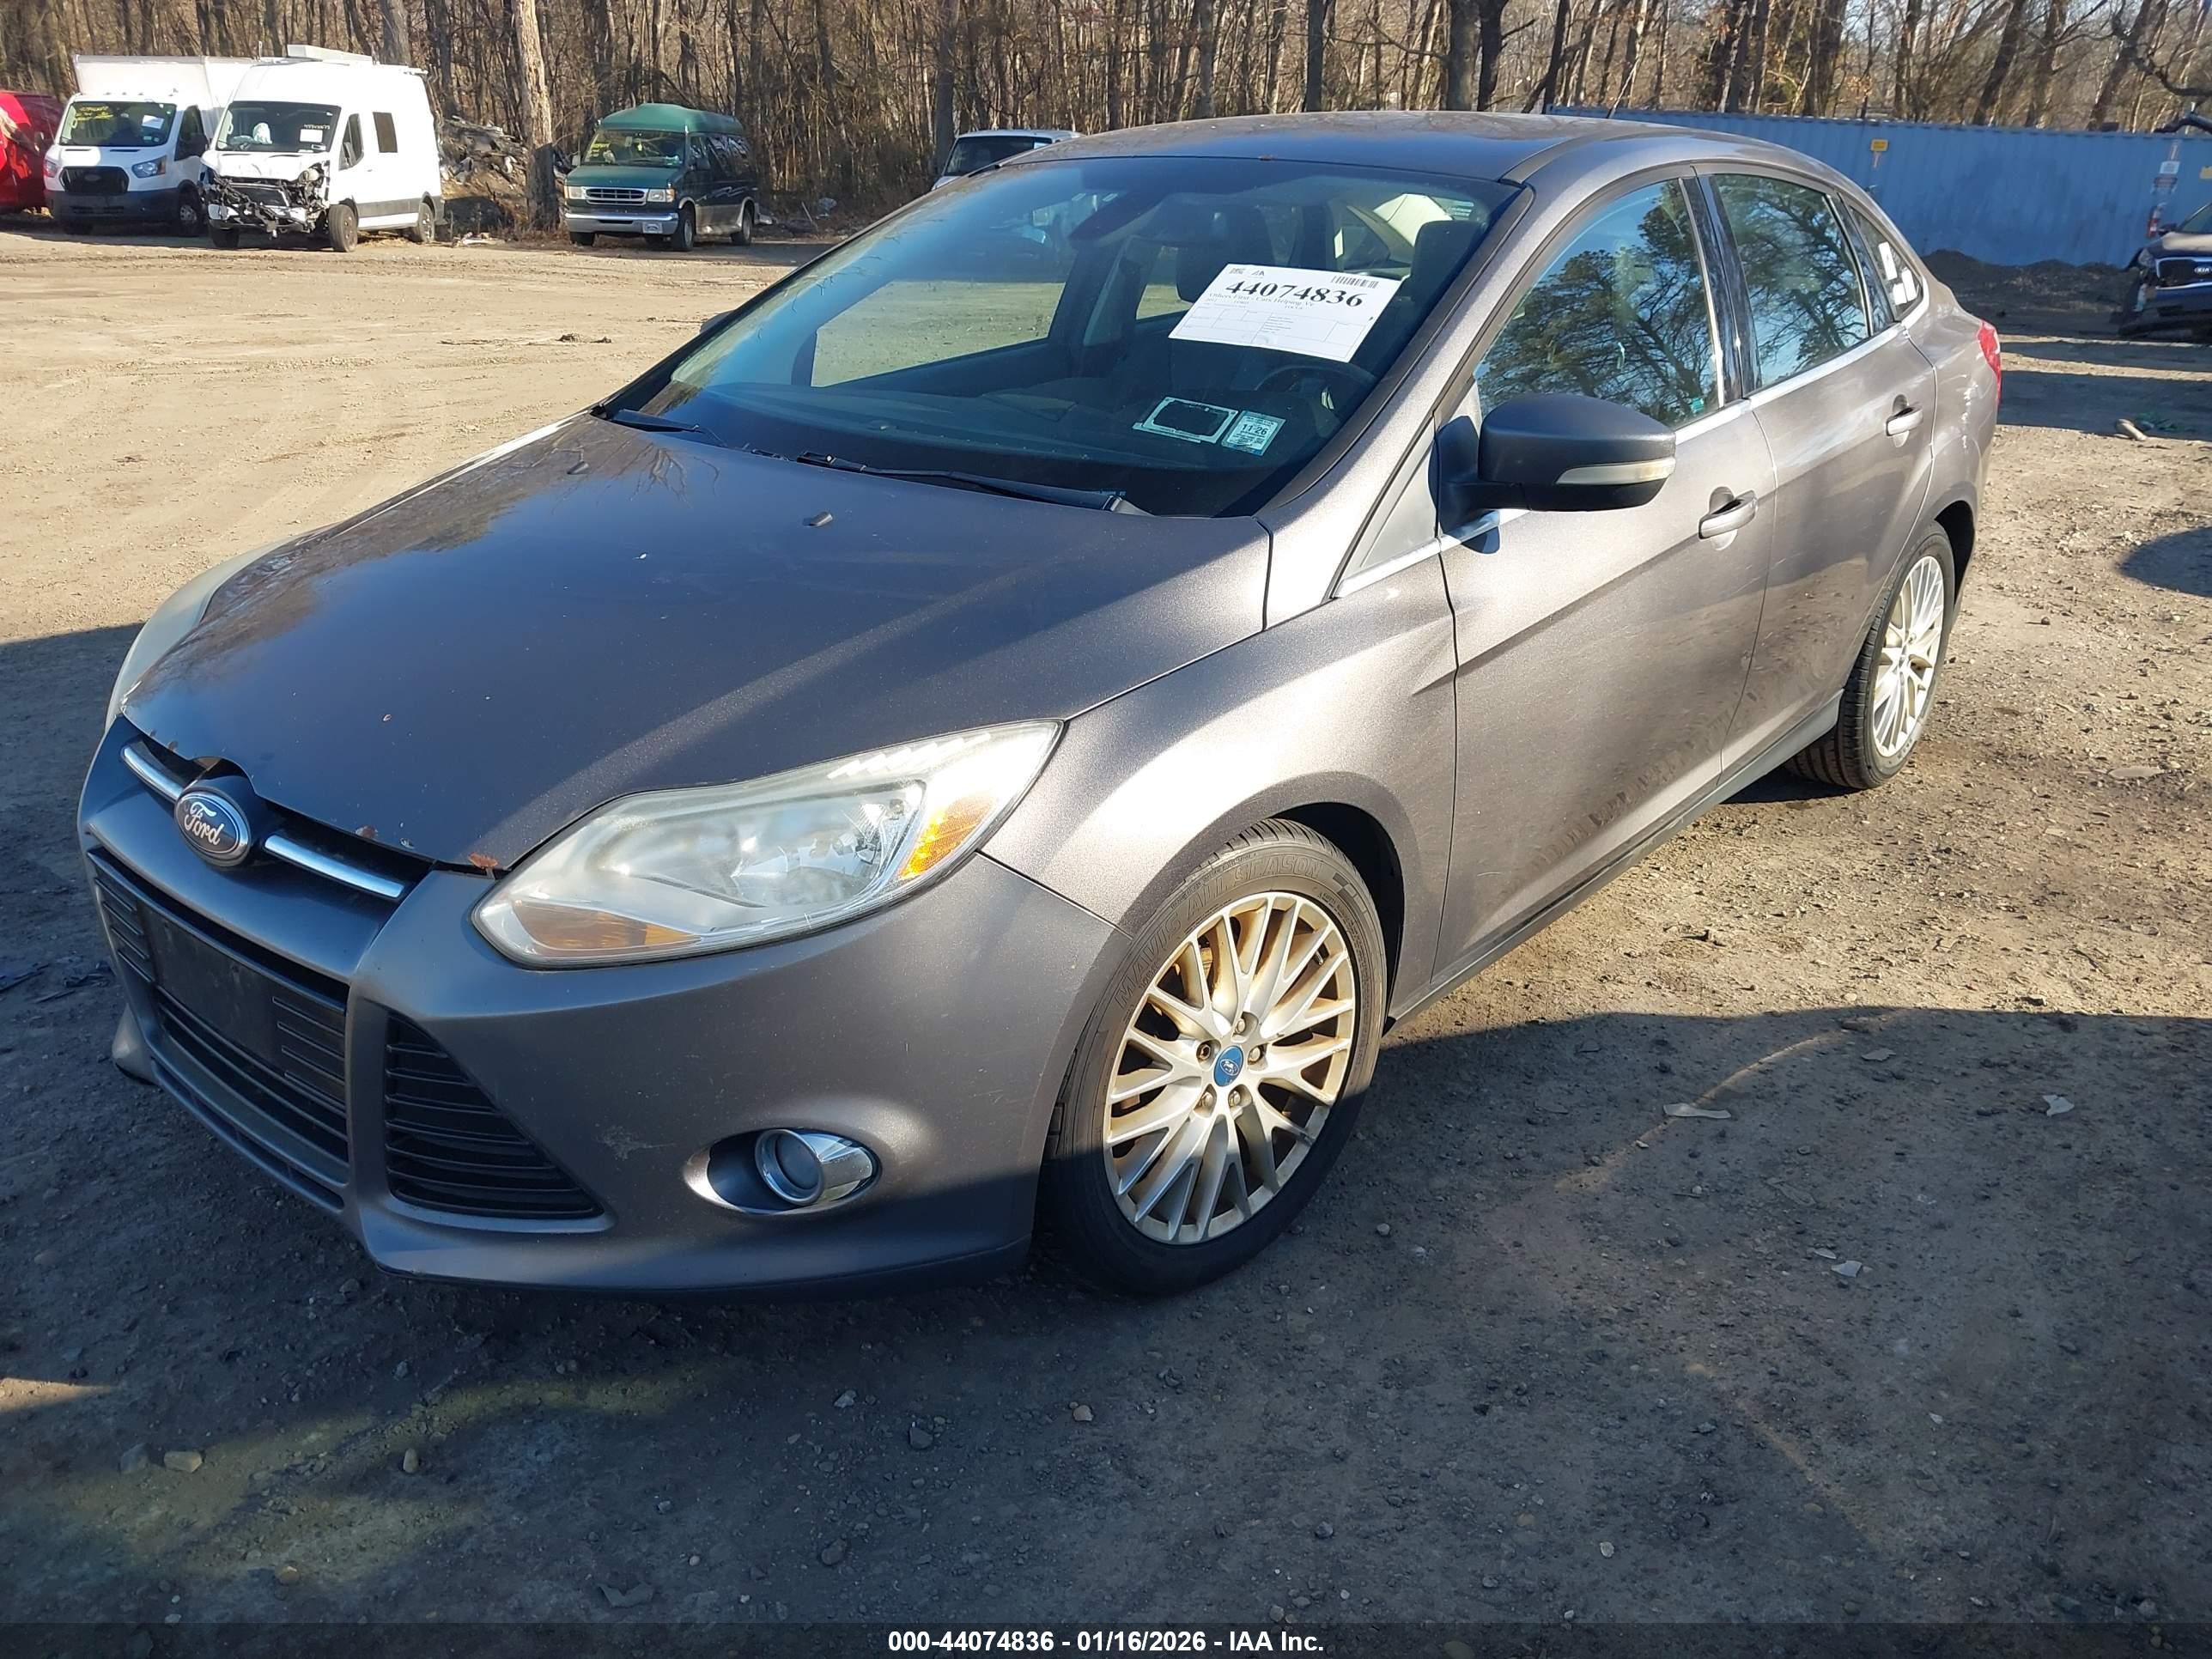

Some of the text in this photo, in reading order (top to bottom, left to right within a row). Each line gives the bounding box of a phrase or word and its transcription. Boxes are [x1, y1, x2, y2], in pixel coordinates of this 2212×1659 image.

[1225, 281, 1367, 307] 44074836
[1255, 426, 1268, 435] 26
[184, 801, 225, 846] Ford
[1114, 910, 1182, 1011] MAVIS
[1187, 874, 1231, 917] ALL
[1234, 854, 1322, 883] SEASON
